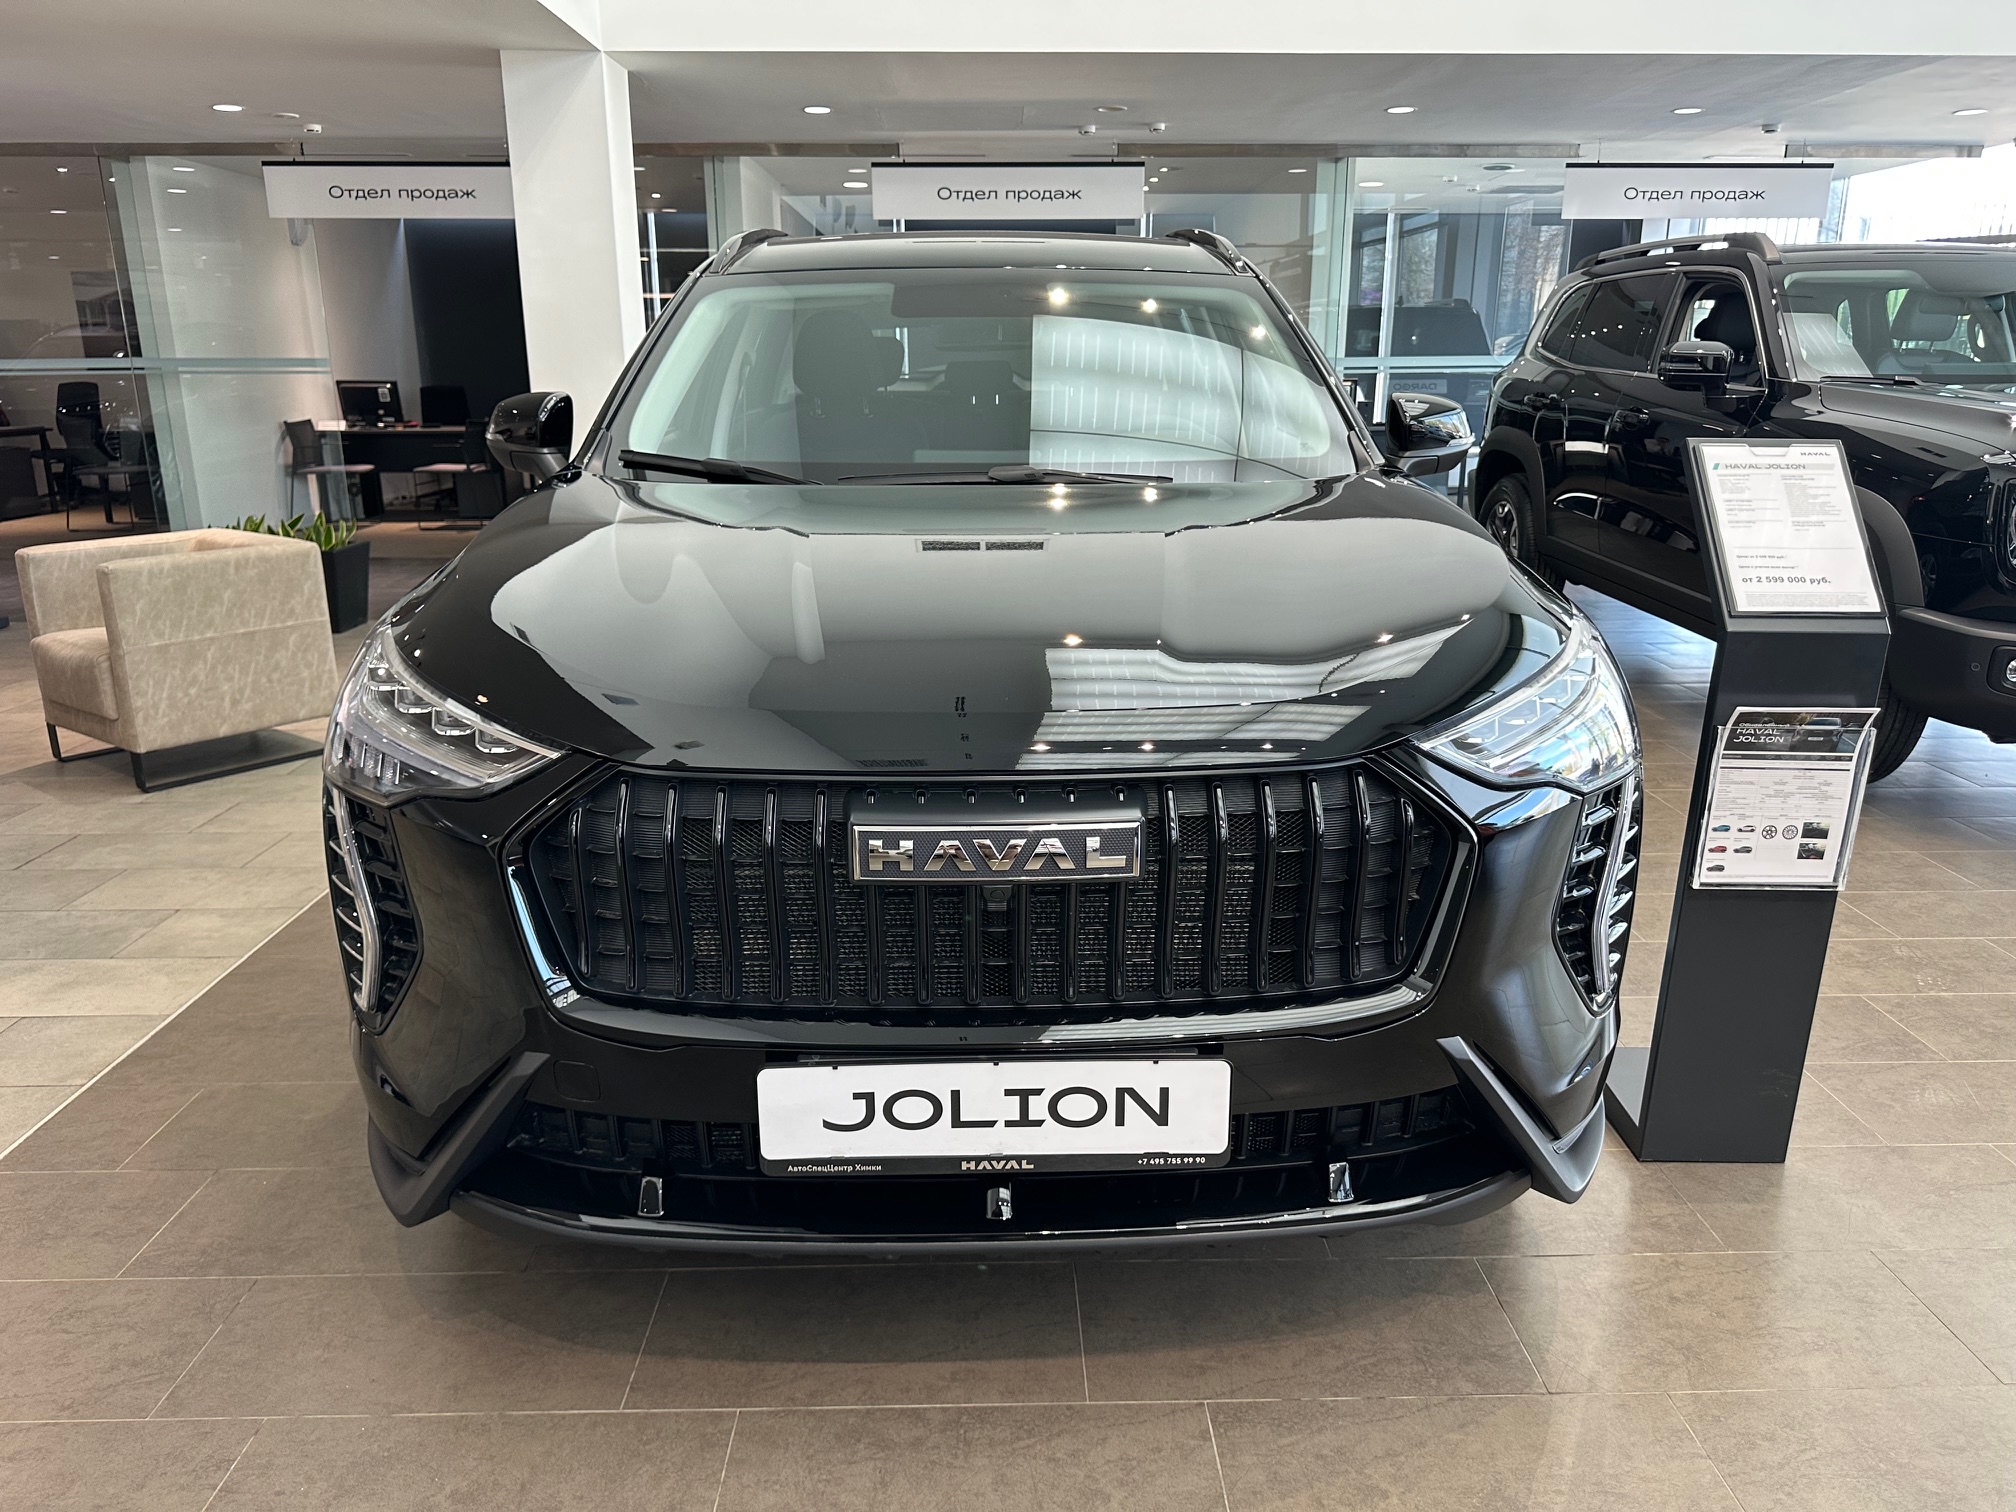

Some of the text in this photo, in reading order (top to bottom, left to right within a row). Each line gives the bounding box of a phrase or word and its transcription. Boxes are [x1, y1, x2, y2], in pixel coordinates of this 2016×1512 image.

[328, 185, 477, 201] Отдел продаж
[937, 187, 1082, 203] Отдел продаж
[1623, 187, 1766, 203] Отдел продаж
[1809, 576, 1831, 585] руб.
[868, 836, 1126, 871] HAVAL
[822, 1086, 1170, 1132] JOLION
[787, 1163, 882, 1173] АвтоСпецЦентр Химки
[961, 1159, 1034, 1170] HAVAL
